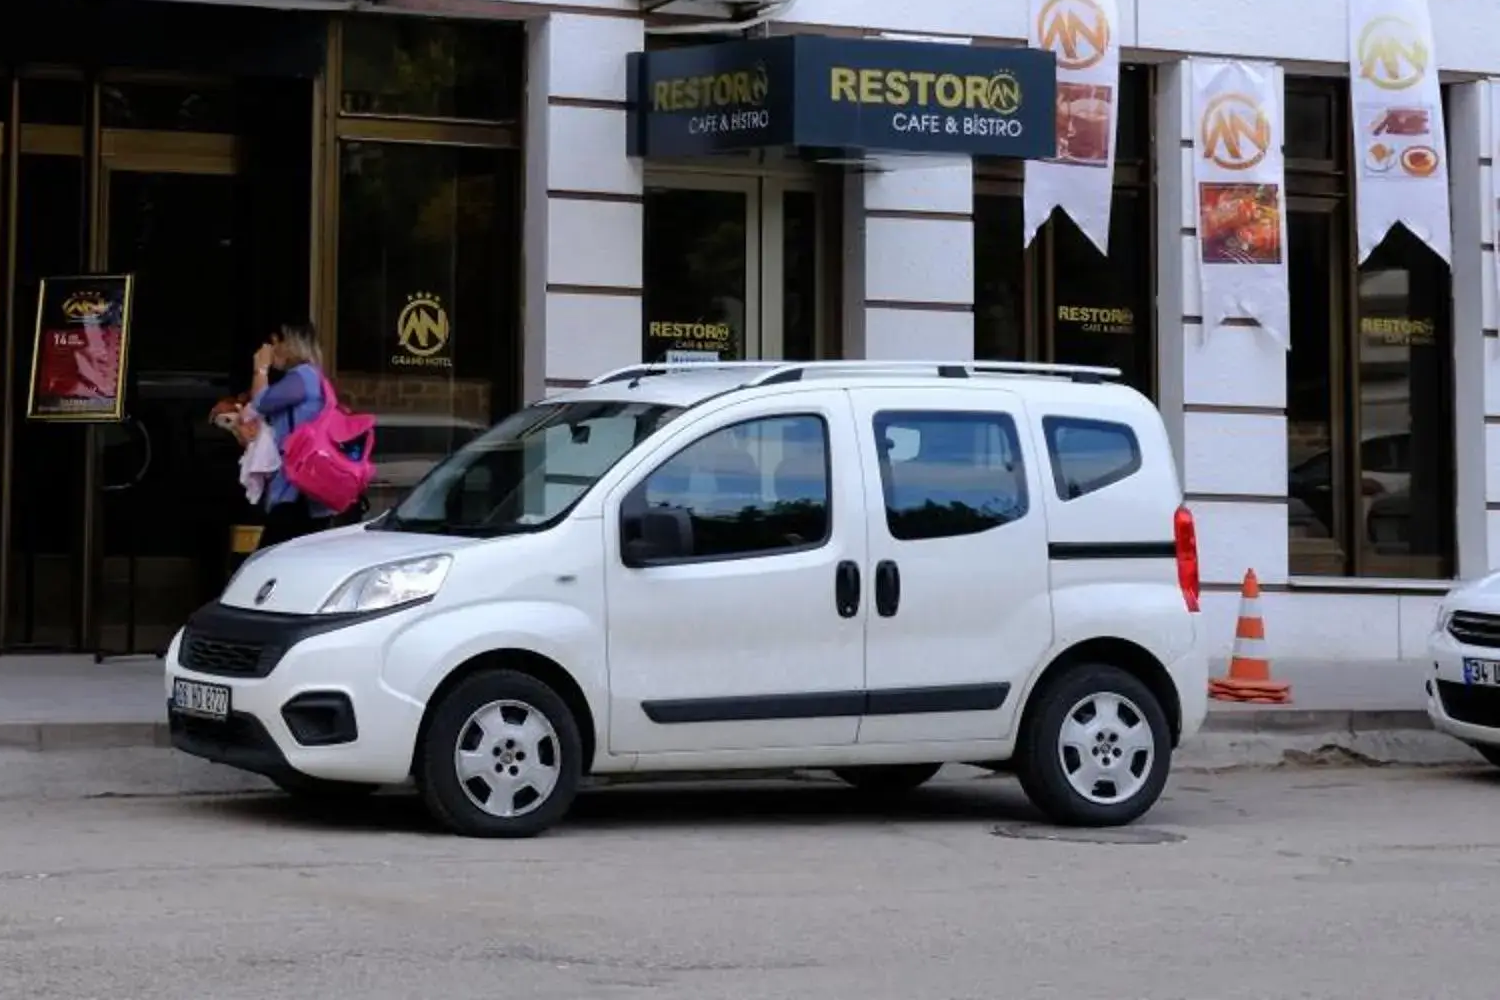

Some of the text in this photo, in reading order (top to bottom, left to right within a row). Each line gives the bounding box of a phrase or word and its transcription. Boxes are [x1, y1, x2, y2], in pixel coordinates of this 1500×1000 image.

[689, 113, 717, 134] CAFE
[719, 114, 729, 131] &
[893, 113, 940, 134] CAFE
[945, 116, 959, 134] &
[391, 355, 453, 367] GRAND HOTEL
[1471, 661, 1488, 683] 34
